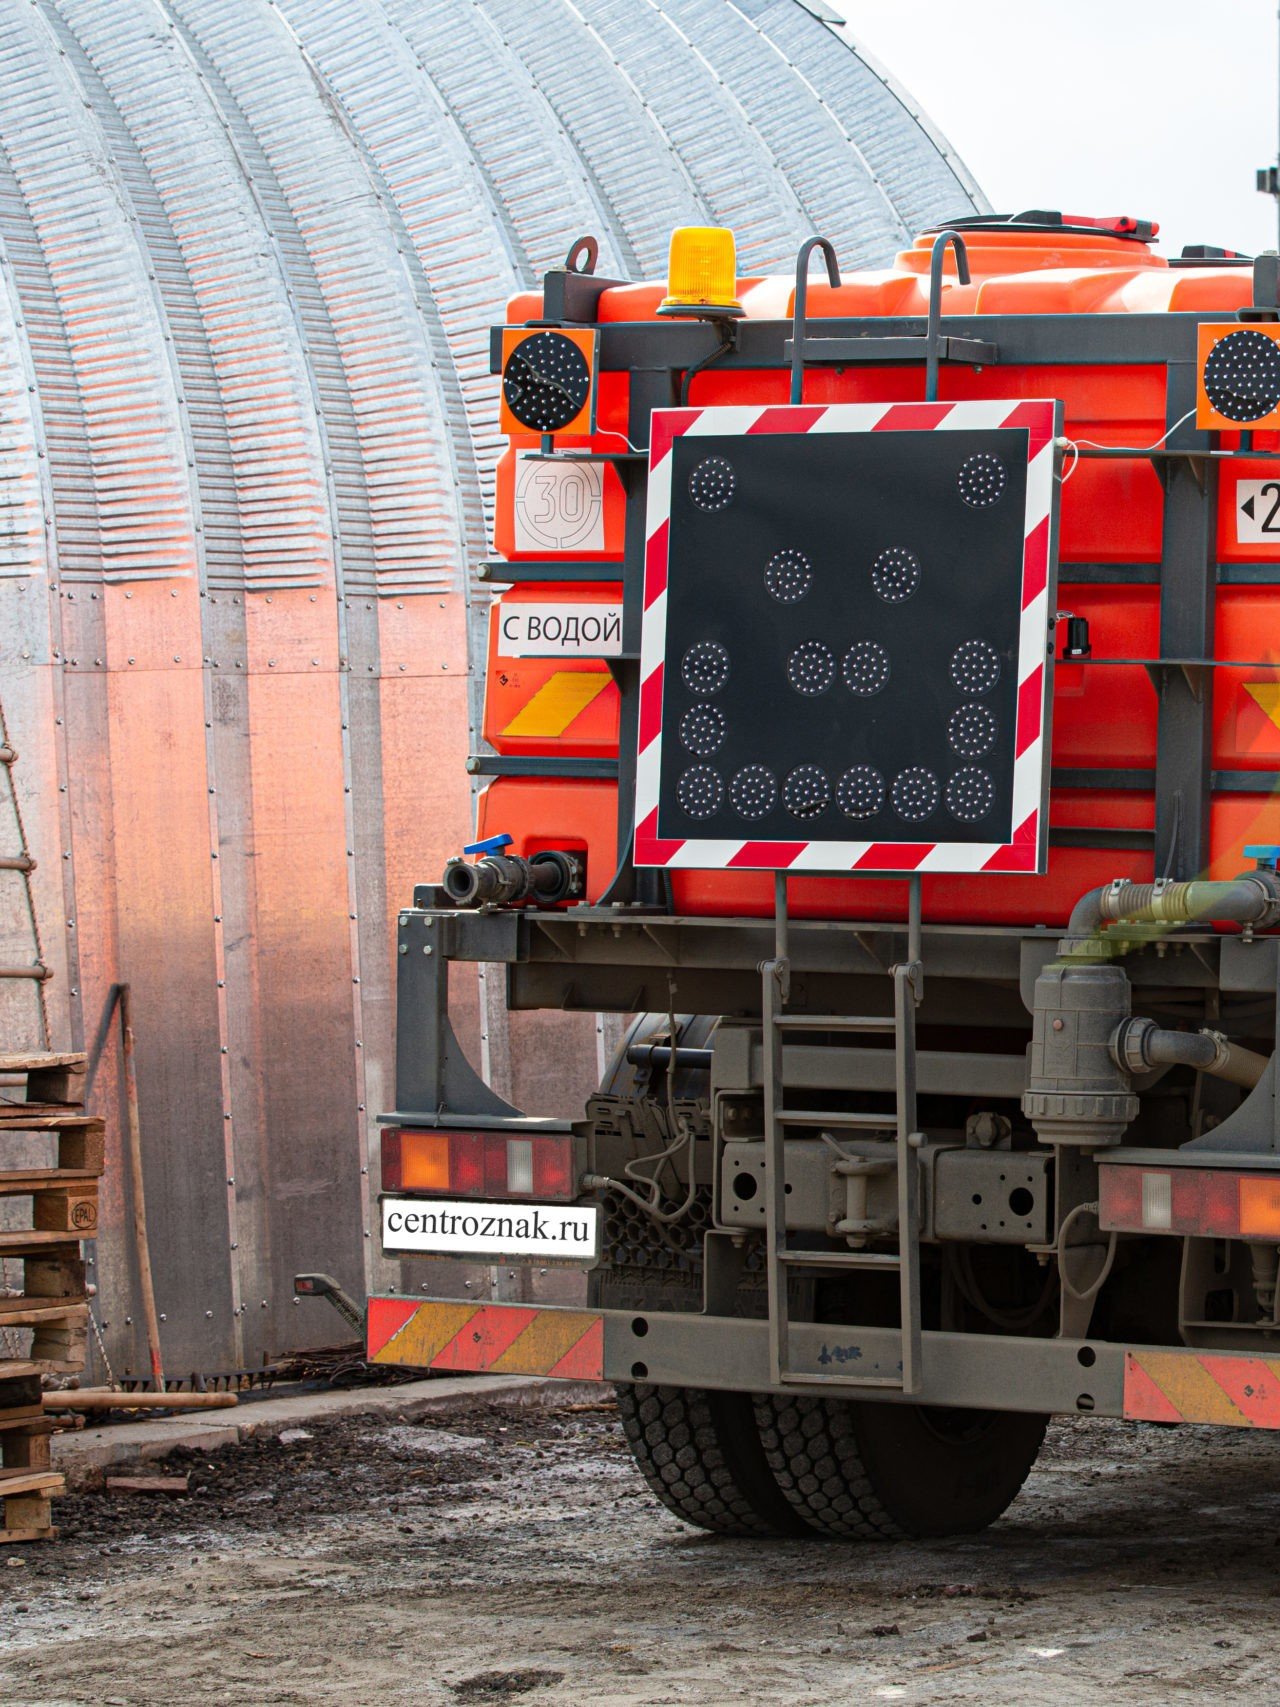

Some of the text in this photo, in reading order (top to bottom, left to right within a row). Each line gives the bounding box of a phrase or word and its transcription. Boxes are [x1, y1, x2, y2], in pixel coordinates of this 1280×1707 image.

[534, 474, 585, 524] 30
[503, 612, 620, 646] С ВОДОЙ
[75, 1207, 93, 1224] EPAL
